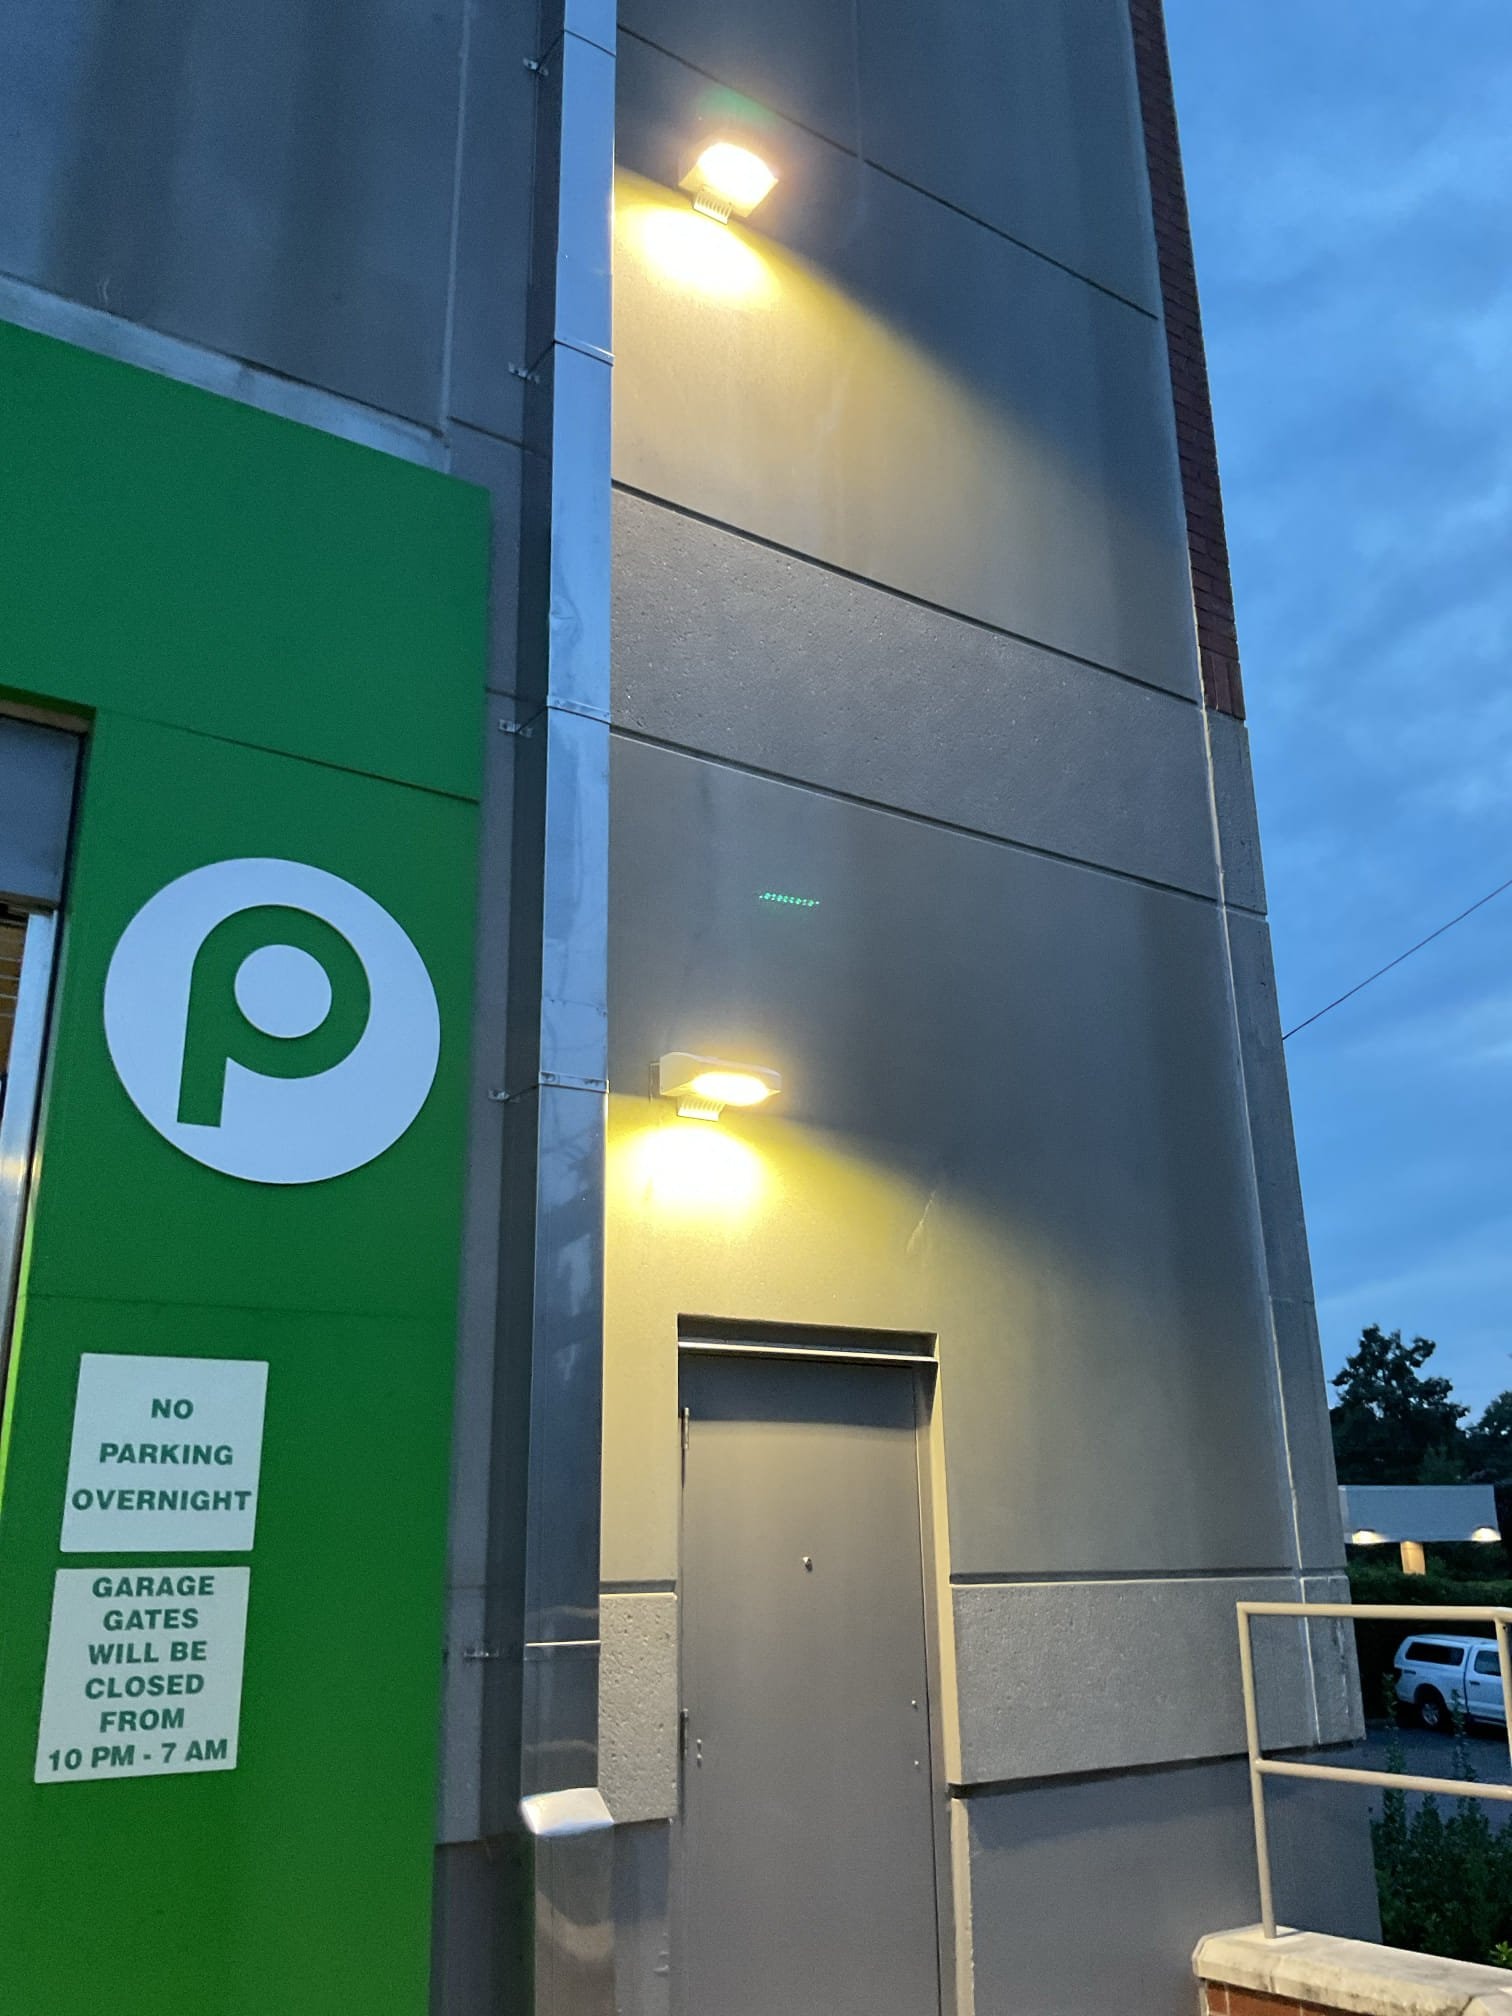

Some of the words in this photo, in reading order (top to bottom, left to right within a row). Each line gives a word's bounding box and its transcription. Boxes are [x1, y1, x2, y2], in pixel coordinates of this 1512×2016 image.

[150, 1397, 194, 1420] NO
[98, 1443, 234, 1466] PARKING
[71, 1488, 252, 1511] OVERNIGHT
[91, 1575, 215, 1598] GARAGE
[102, 1607, 199, 1631] GATES
[88, 1641, 159, 1665] WILL
[169, 1640, 208, 1662] BE
[84, 1673, 205, 1699] CLOSED
[98, 1707, 185, 1733] FROM
[48, 1748, 83, 1771] 10
[90, 1744, 136, 1768] PM
[160, 1742, 177, 1764] 7
[184, 1738, 228, 1761] AM
